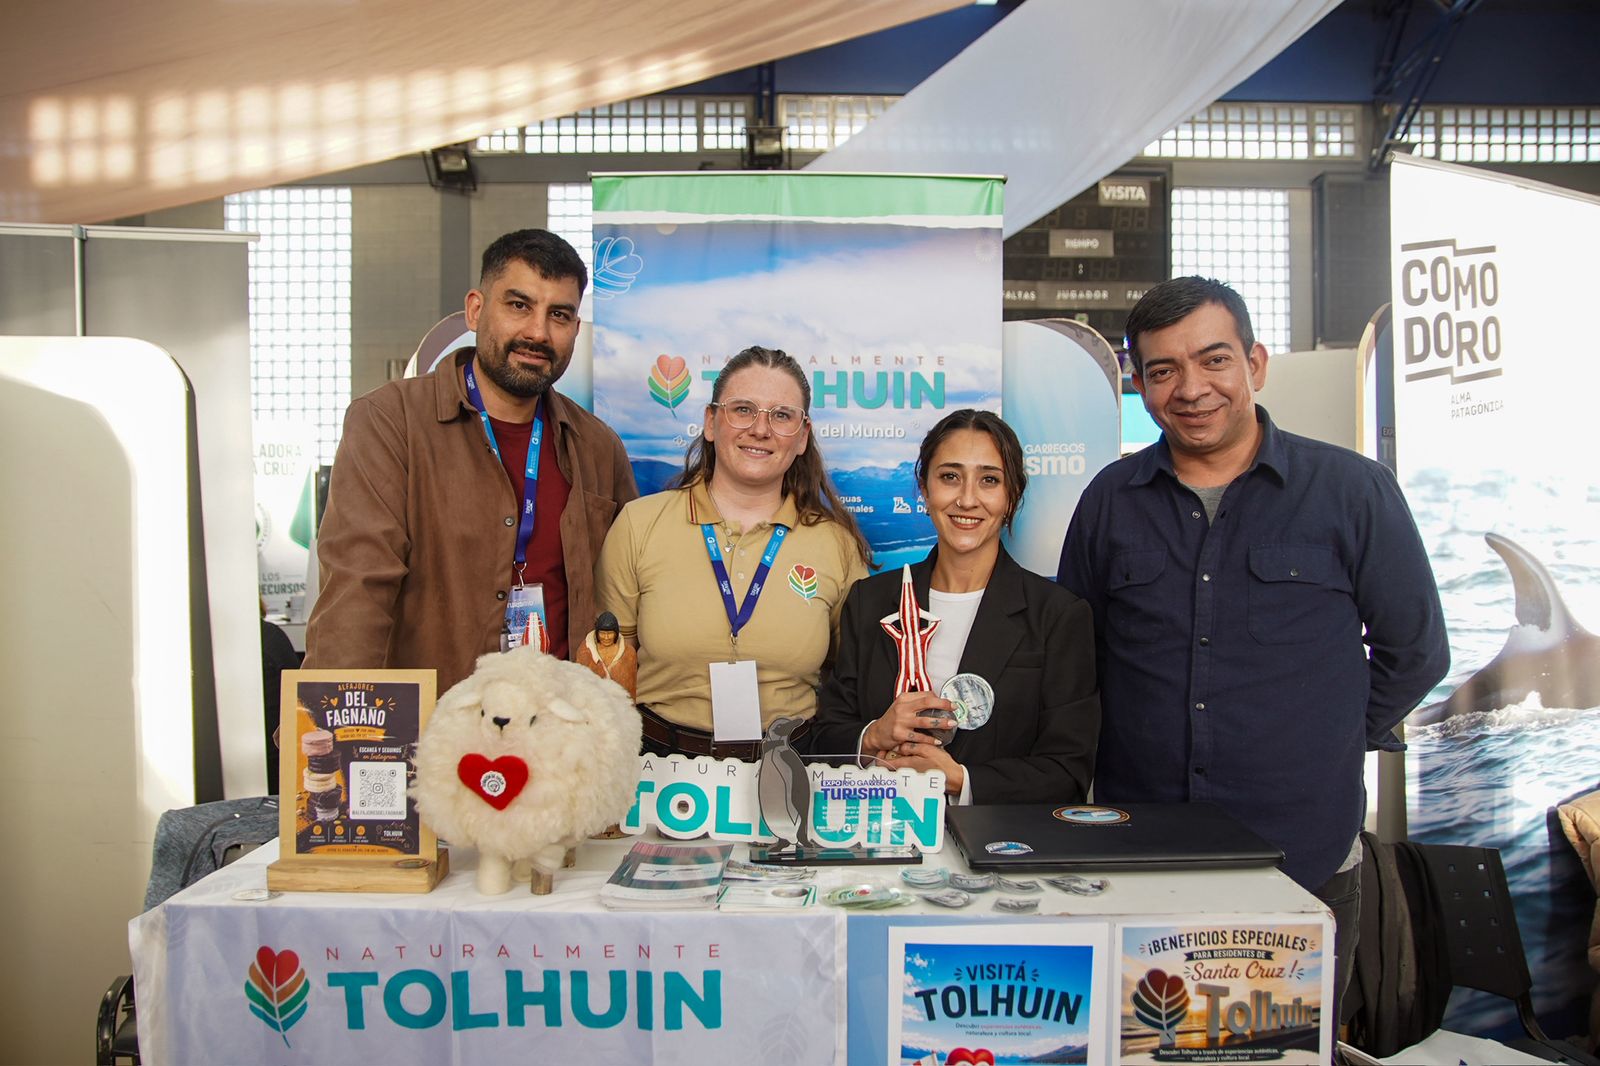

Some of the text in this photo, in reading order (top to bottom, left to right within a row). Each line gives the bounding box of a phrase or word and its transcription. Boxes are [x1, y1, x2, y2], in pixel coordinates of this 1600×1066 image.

[1101, 186, 1146, 200] VISITA
[1065, 238, 1099, 249] TIEMPO
[1056, 289, 1109, 299] JUGADOR
[702, 355, 945, 366] NAALMENTE
[1450, 391, 1471, 405] ALMA
[820, 424, 906, 438] del Mundo
[838, 495, 862, 504] guas
[338, 682, 375, 692] ALFAJORES
[345, 691, 368, 707] DEL
[326, 708, 386, 727] FAGNANO
[626, 780, 939, 847] TOLUIN
[1233, 928, 1308, 951] ESPECIALES
[325, 943, 721, 961] NATURALMENTE
[1193, 949, 1266, 959] PARA RESIDENTES DE
[966, 960, 1028, 982] VISITÁ
[1191, 961, 1240, 981] Santa
[326, 968, 722, 1031] TOLHUIN
[914, 984, 1083, 1025] TOLHUIN
[1195, 983, 1313, 1039] Tolhuin
